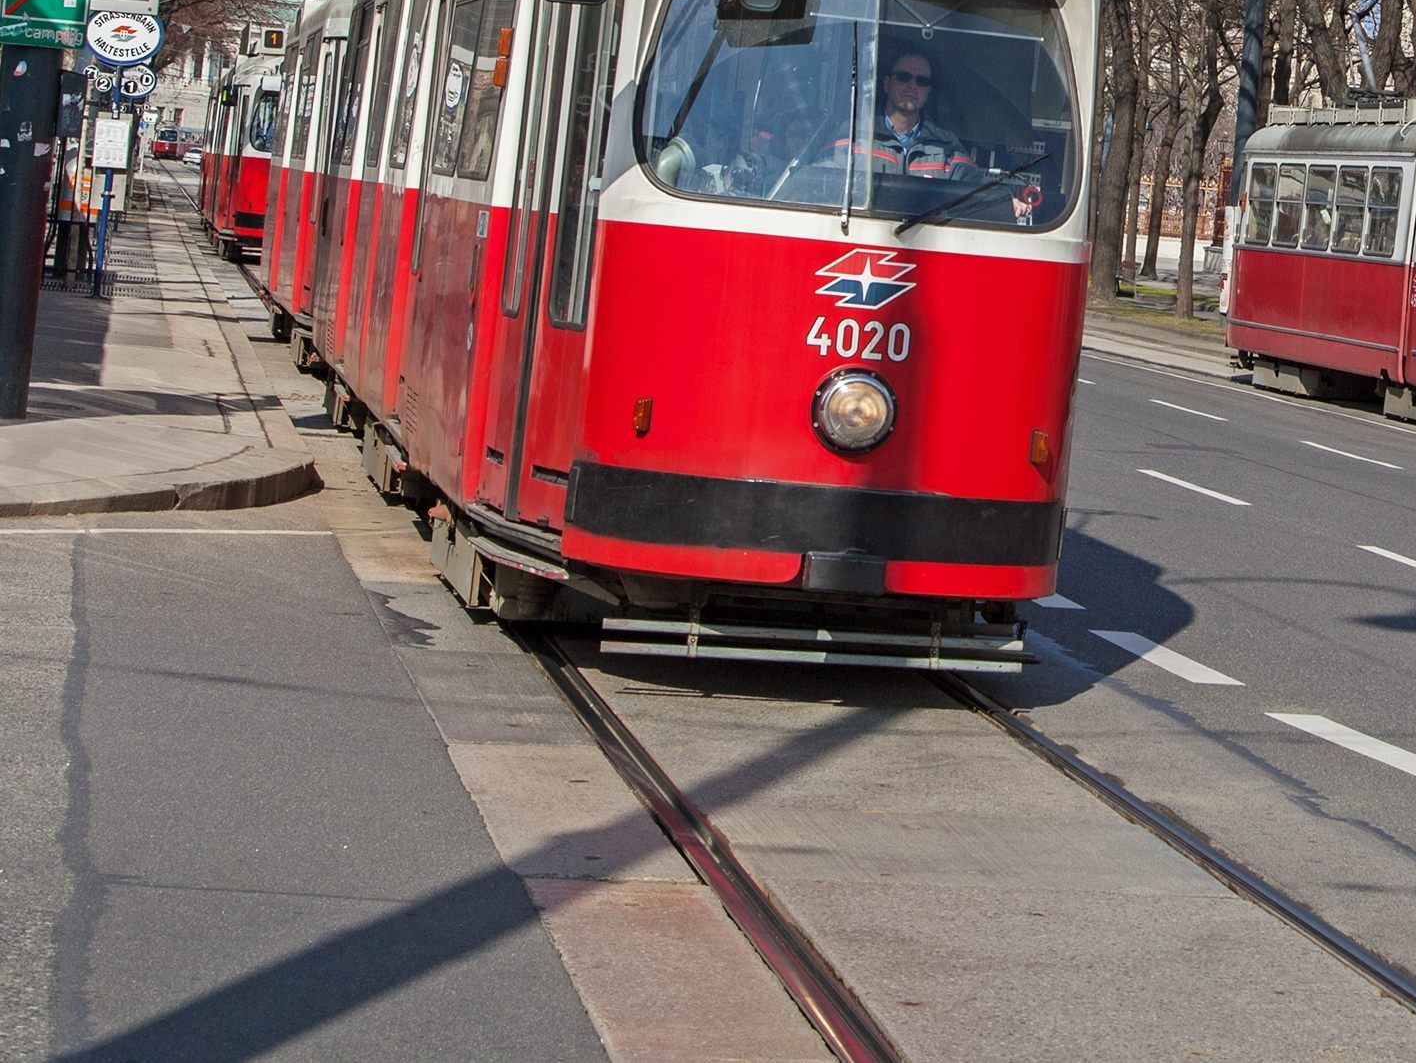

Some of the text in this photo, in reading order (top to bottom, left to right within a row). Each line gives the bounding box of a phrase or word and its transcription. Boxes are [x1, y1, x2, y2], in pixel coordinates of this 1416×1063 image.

[94, 12, 156, 34] STRASSENBAHN
[25, 27, 83, 46] campg
[271, 32, 277, 45] 1
[94, 36, 151, 58] HALTESTELLE
[86, 69, 98, 79] 71
[142, 74, 152, 85] D
[99, 79, 108, 90] 2
[127, 81, 134, 92] 1
[806, 316, 911, 362] 4020
